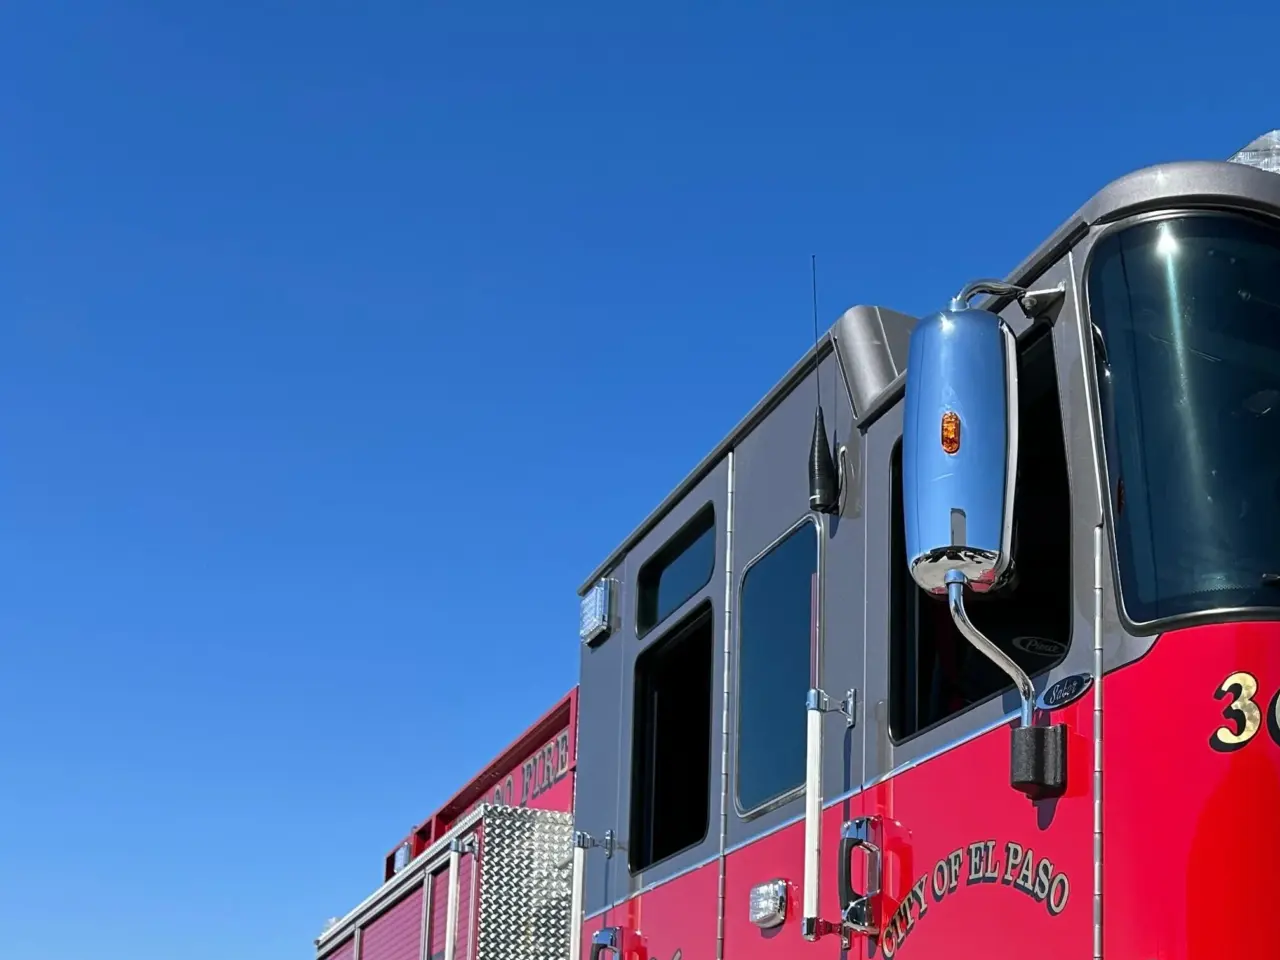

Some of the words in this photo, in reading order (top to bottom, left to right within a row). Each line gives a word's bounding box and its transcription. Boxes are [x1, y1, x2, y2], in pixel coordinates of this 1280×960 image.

[522, 728, 569, 806] FIRE
[932, 848, 963, 900] OF
[967, 840, 1000, 884] EL
[1003, 841, 1069, 915] PASO
